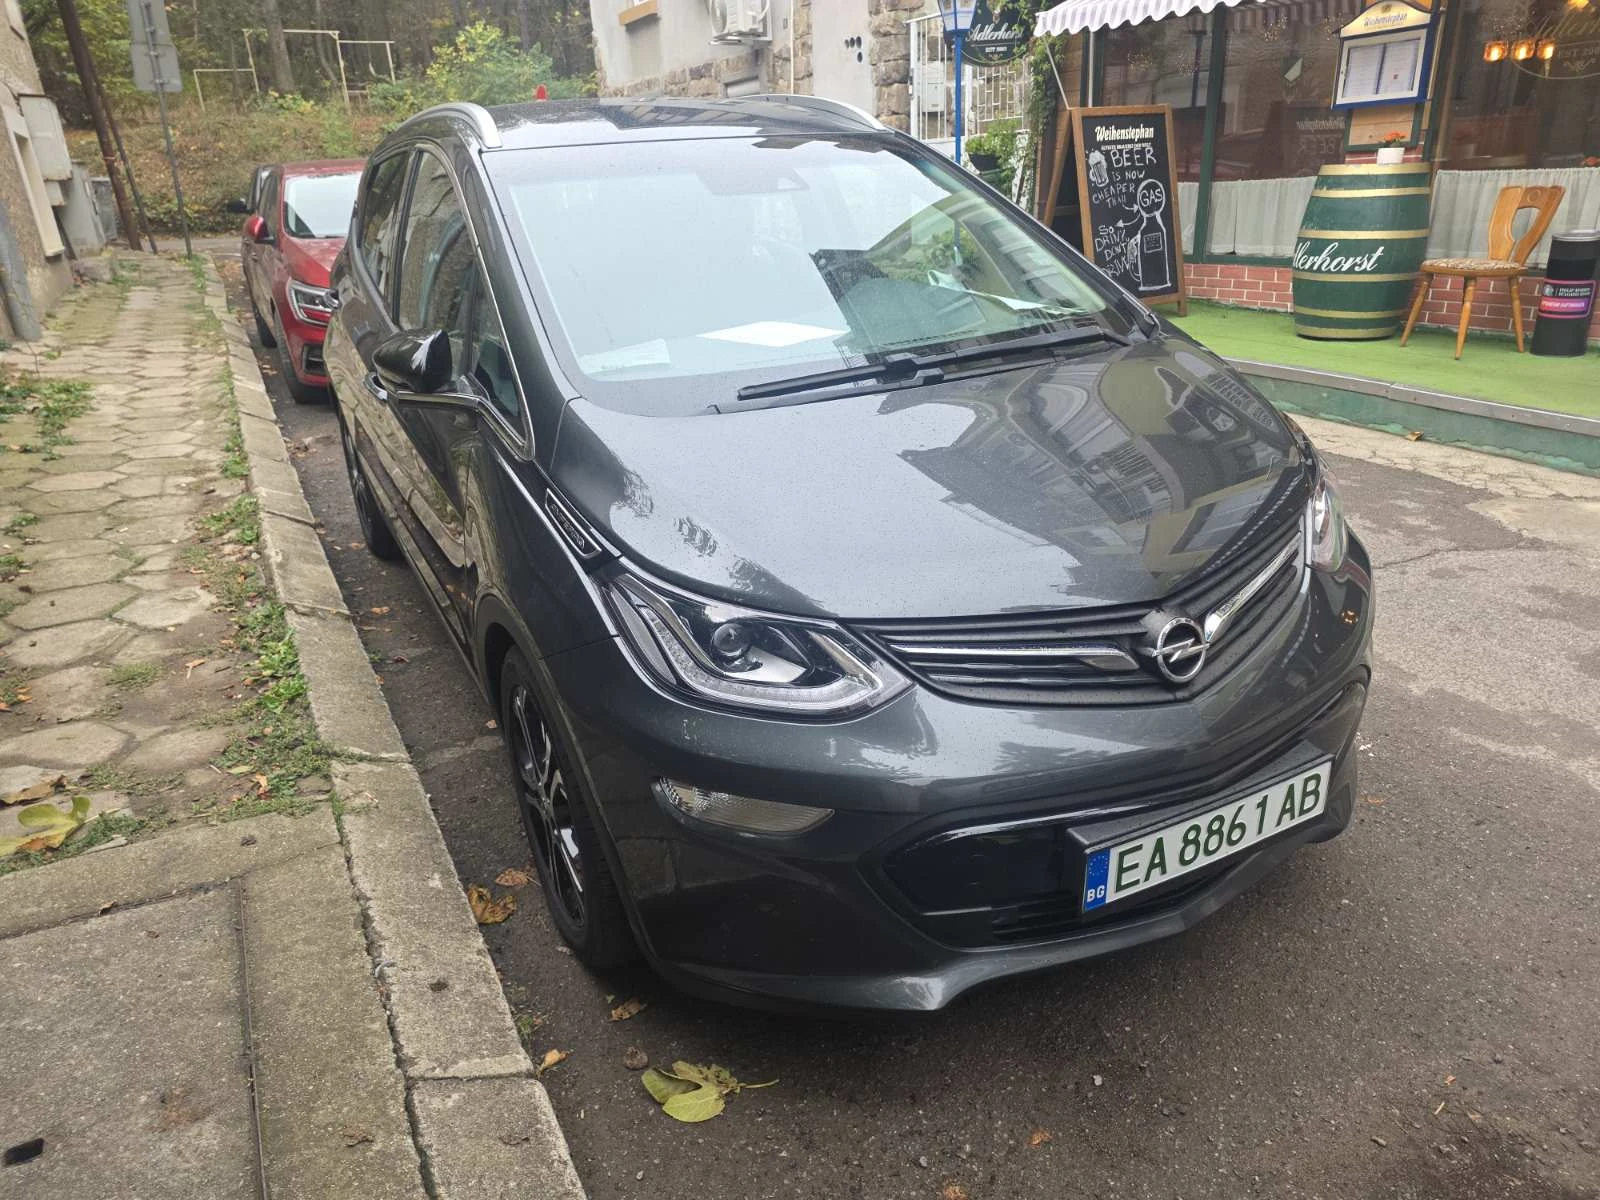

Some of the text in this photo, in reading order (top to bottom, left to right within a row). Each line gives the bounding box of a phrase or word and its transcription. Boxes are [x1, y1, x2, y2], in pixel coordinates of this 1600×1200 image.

[1095, 123, 1154, 142] Weihenstephan
[1110, 147, 1157, 168] BEER
[1125, 170, 1145, 180] NOW
[1092, 182, 1135, 204] CHEAPER
[1140, 188, 1163, 207] GAS
[1115, 773, 1322, 893] EA 8861 AB
[1086, 885, 1105, 902] BG
